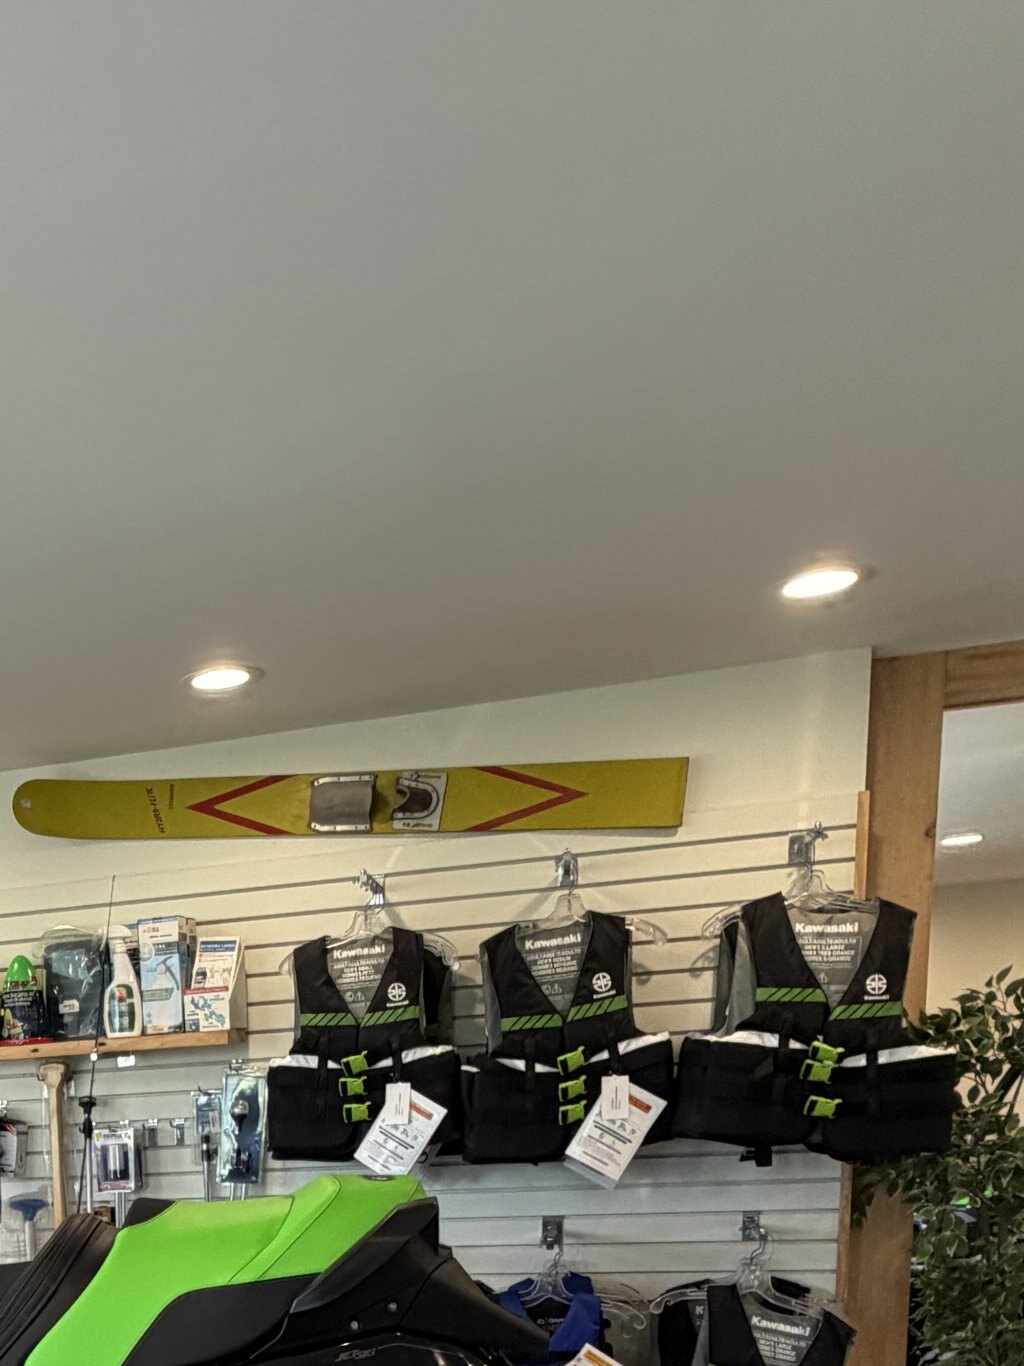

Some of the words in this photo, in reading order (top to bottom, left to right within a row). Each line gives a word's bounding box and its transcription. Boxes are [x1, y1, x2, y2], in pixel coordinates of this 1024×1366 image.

[795, 922, 859, 933] Kawasaki
[524, 932, 582, 950] Kawasaki
[333, 943, 386, 959] Kawasaki
[751, 1315, 811, 1337] Kawasaki
